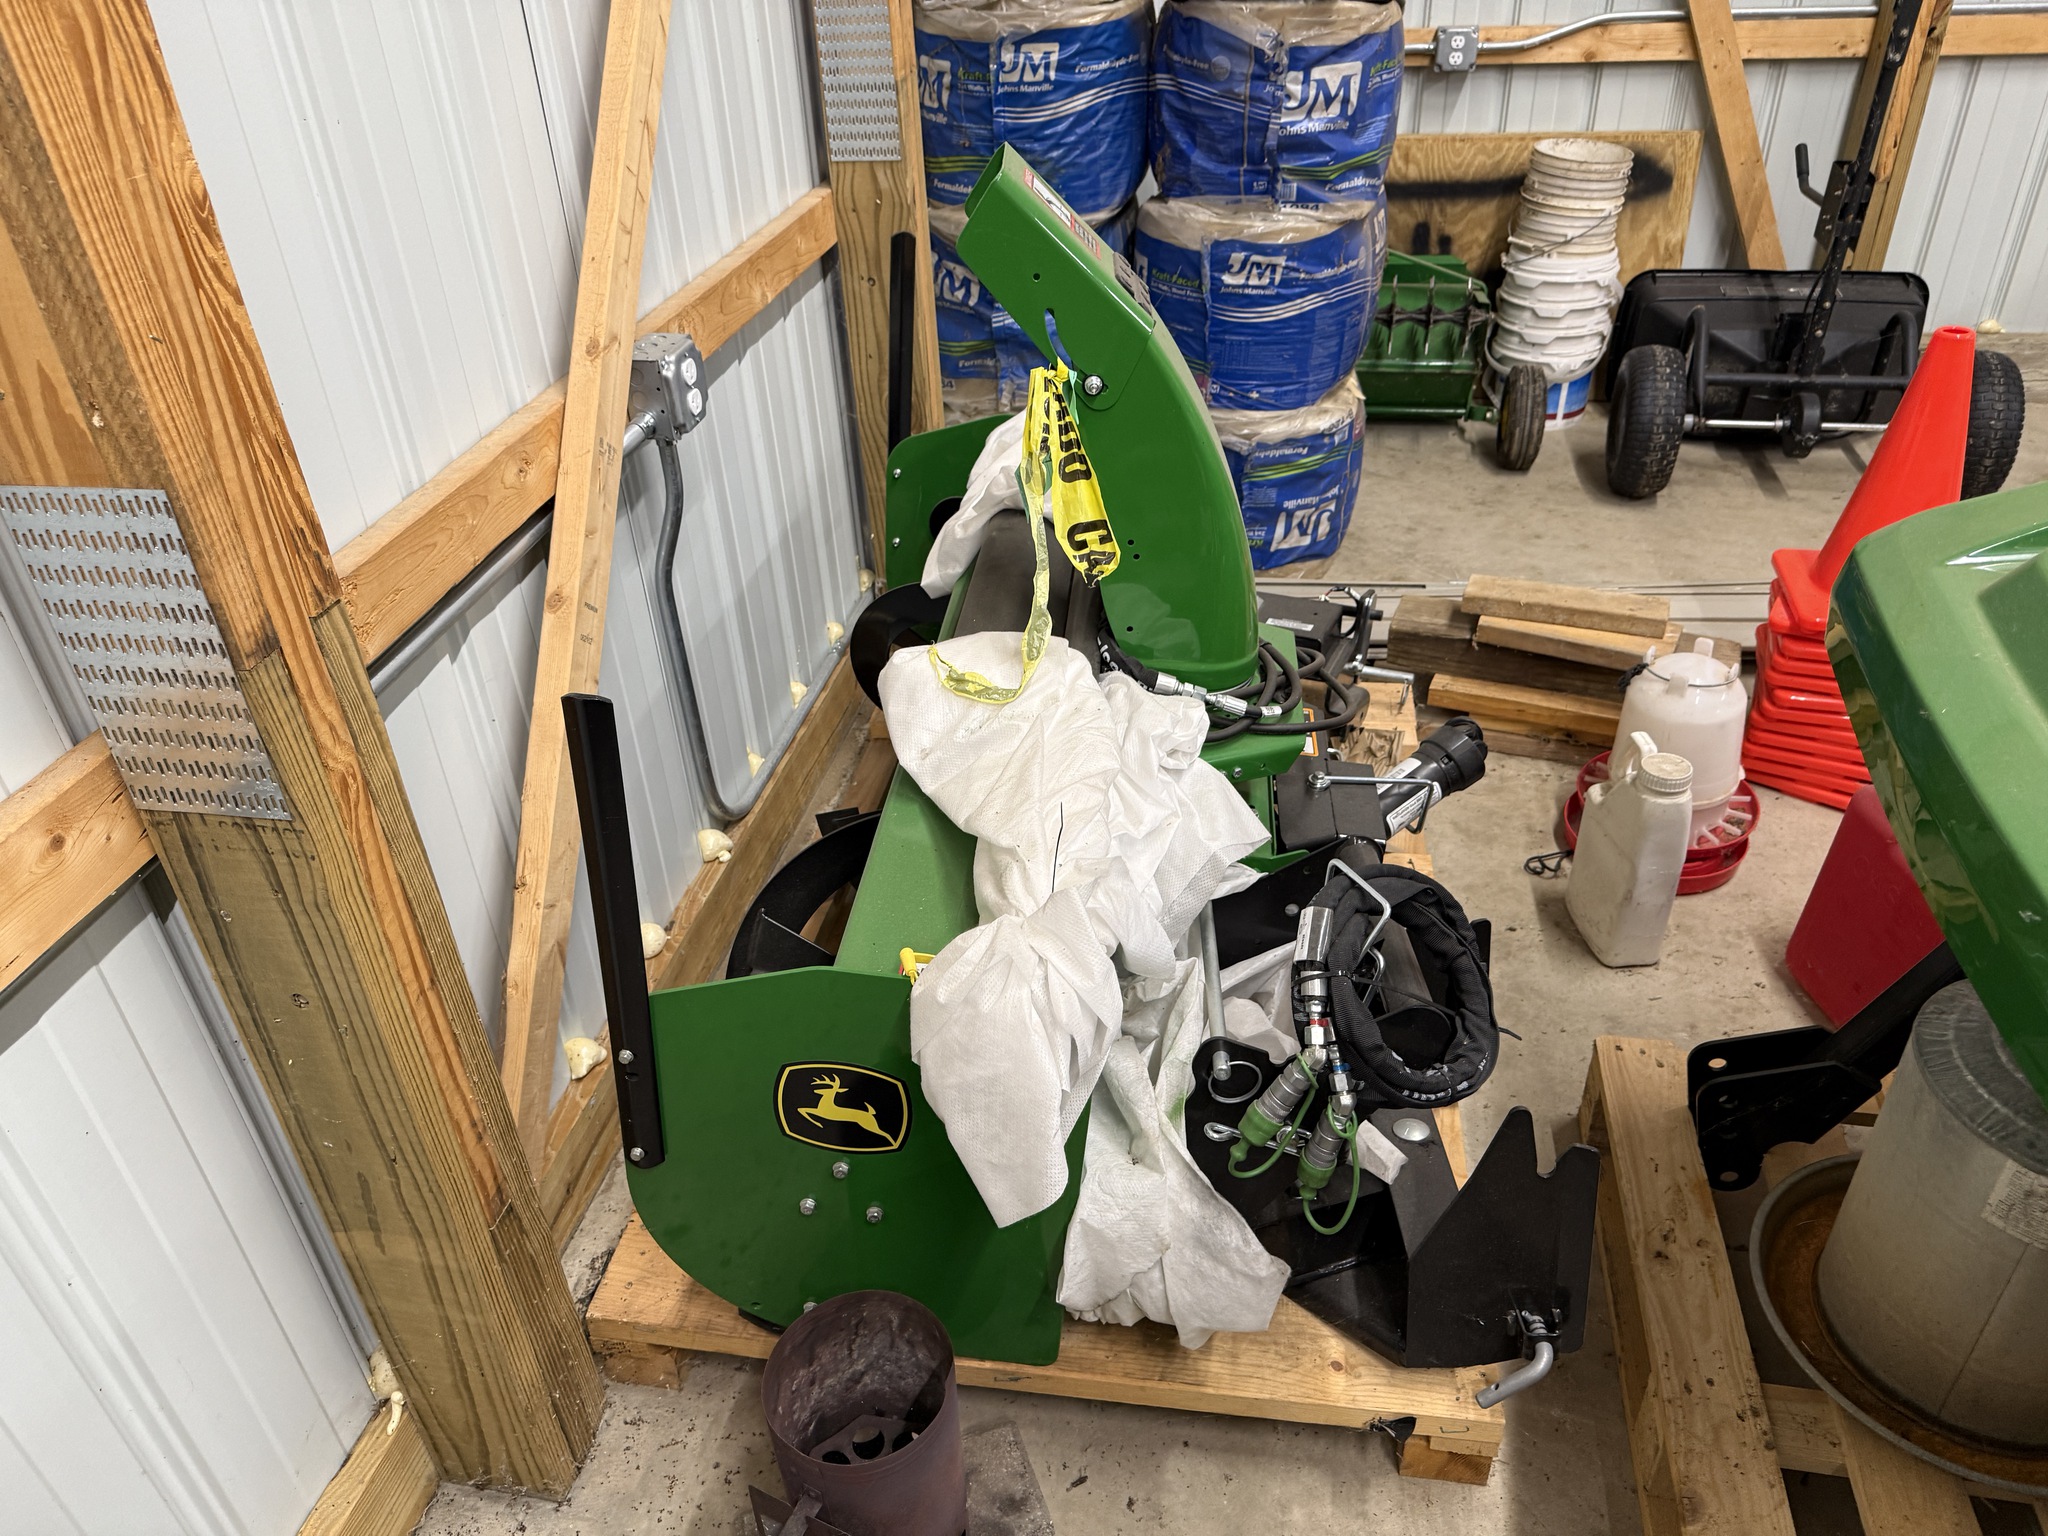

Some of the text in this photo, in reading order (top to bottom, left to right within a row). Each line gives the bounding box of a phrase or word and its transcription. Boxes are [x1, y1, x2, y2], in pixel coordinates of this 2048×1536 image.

[999, 41, 1060, 83] JM
[996, 83, 1054, 95] Johns Manville
[1280, 61, 1363, 123] JM
[1278, 124, 1307, 137] ohns
[1308, 121, 1350, 134] Manville
[1221, 252, 1288, 286] JM
[1243, 286, 1277, 296] Manville
